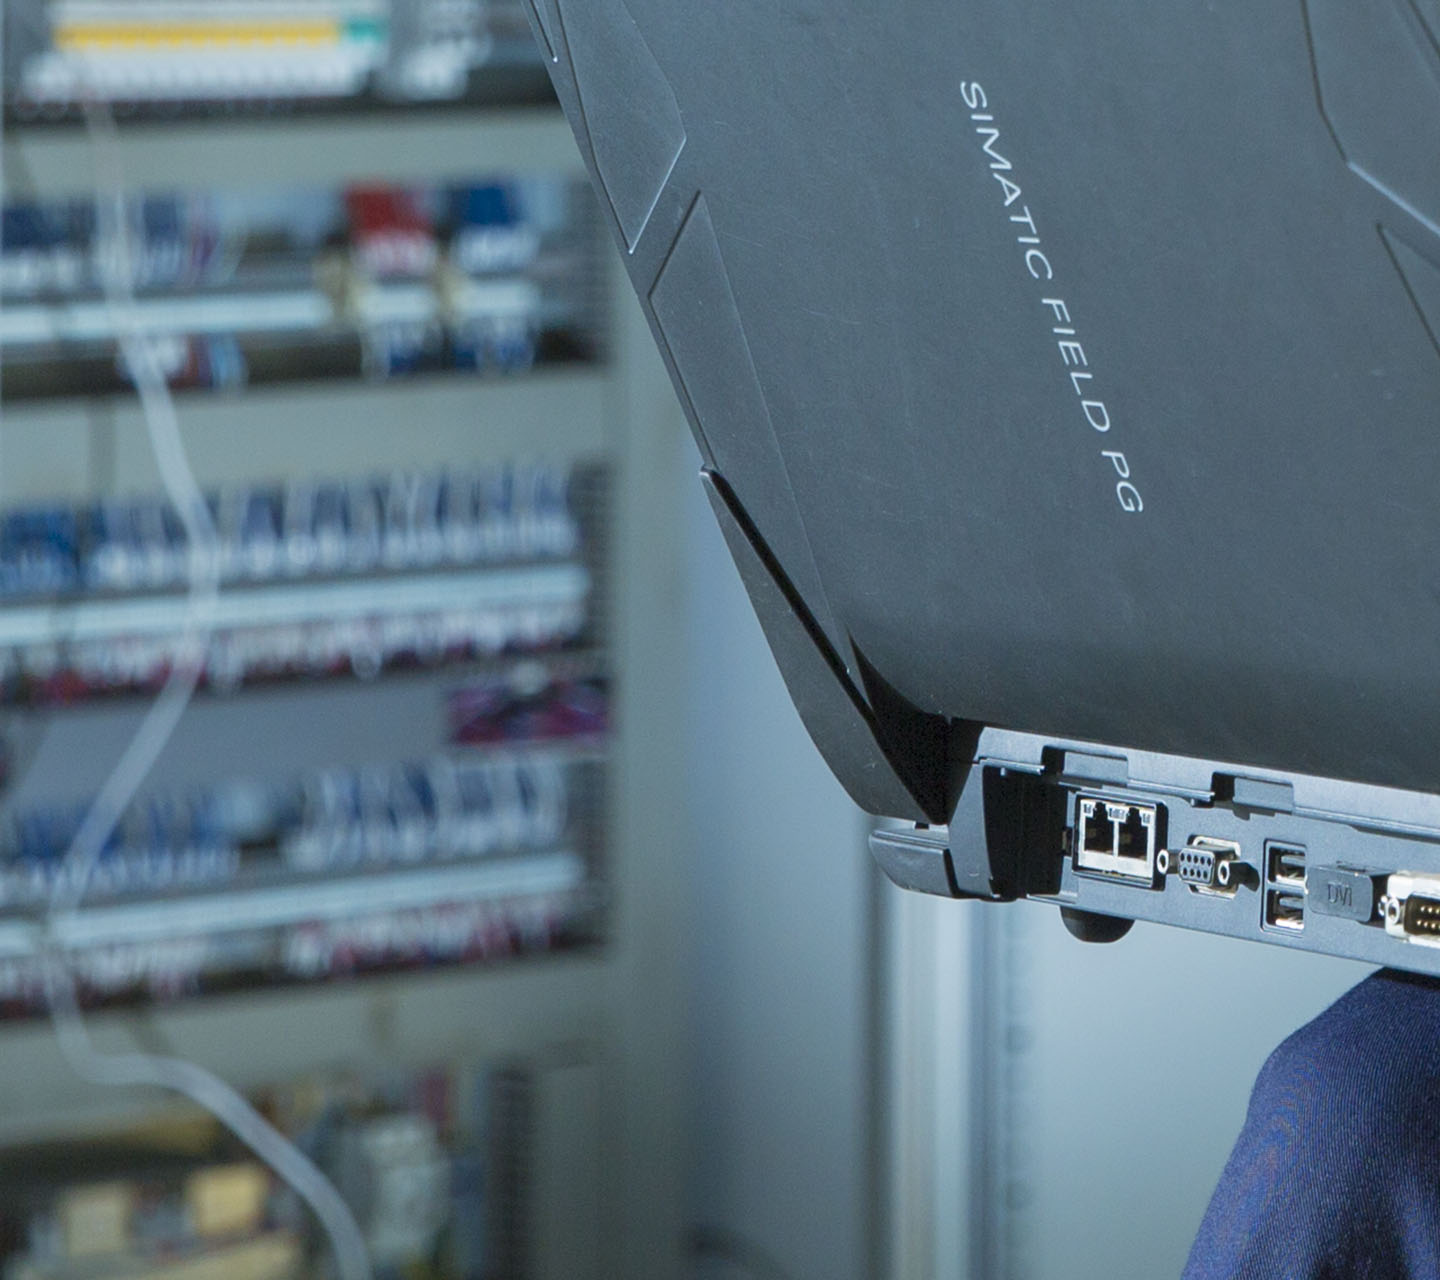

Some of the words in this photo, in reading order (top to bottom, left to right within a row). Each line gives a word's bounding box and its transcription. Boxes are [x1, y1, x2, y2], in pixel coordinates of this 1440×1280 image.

[961, 80, 1053, 280] SIMATIC
[1041, 297, 1112, 433] FIELD
[1101, 450, 1144, 513] PG
[1327, 881, 1353, 907] DVI
